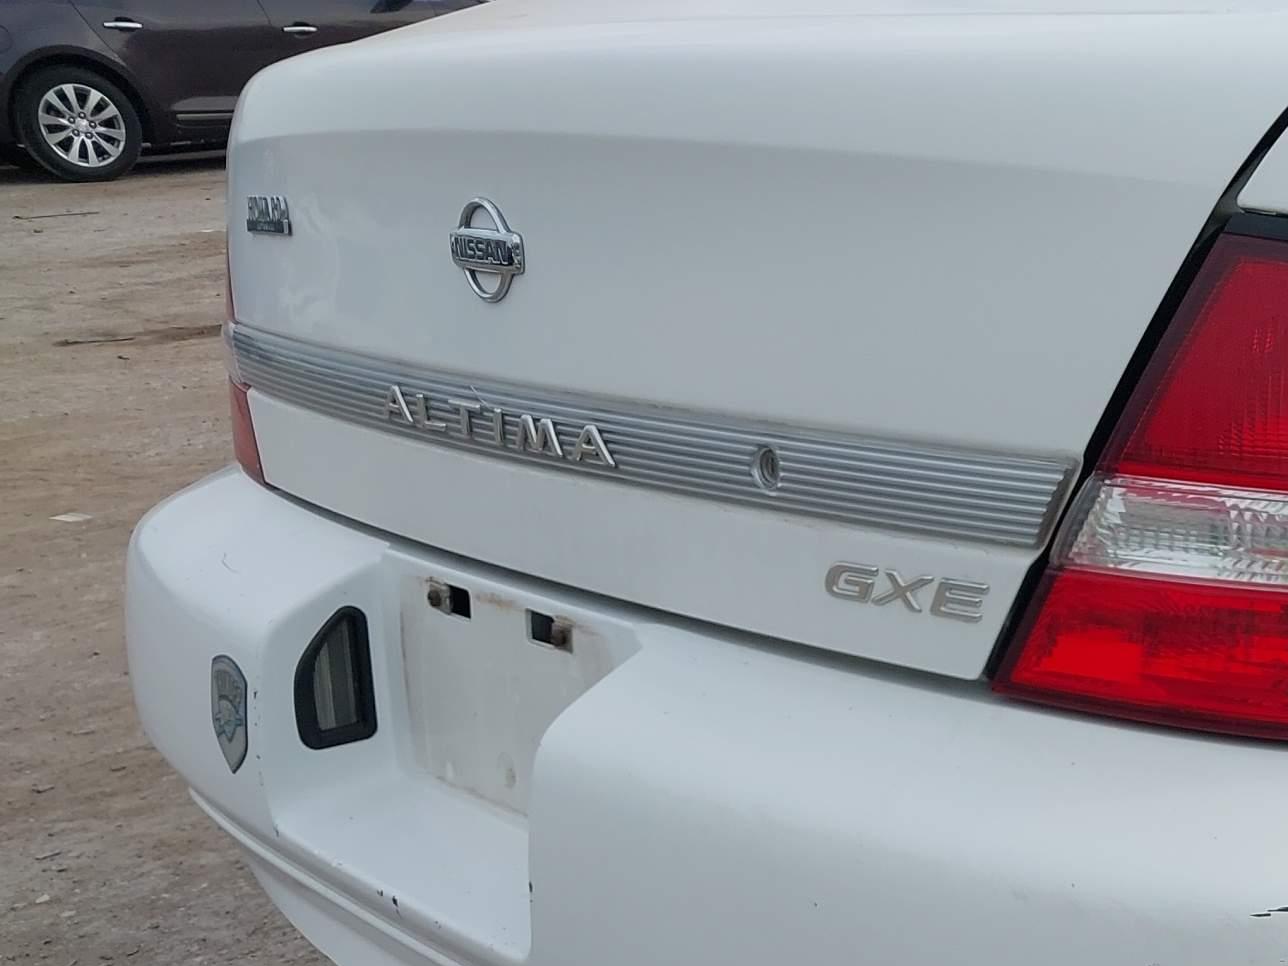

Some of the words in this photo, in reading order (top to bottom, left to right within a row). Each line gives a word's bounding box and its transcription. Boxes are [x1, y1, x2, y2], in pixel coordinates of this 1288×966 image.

[454, 236, 509, 265] NISSAN
[384, 384, 617, 468] ALTIMA
[823, 560, 991, 624] GXE
